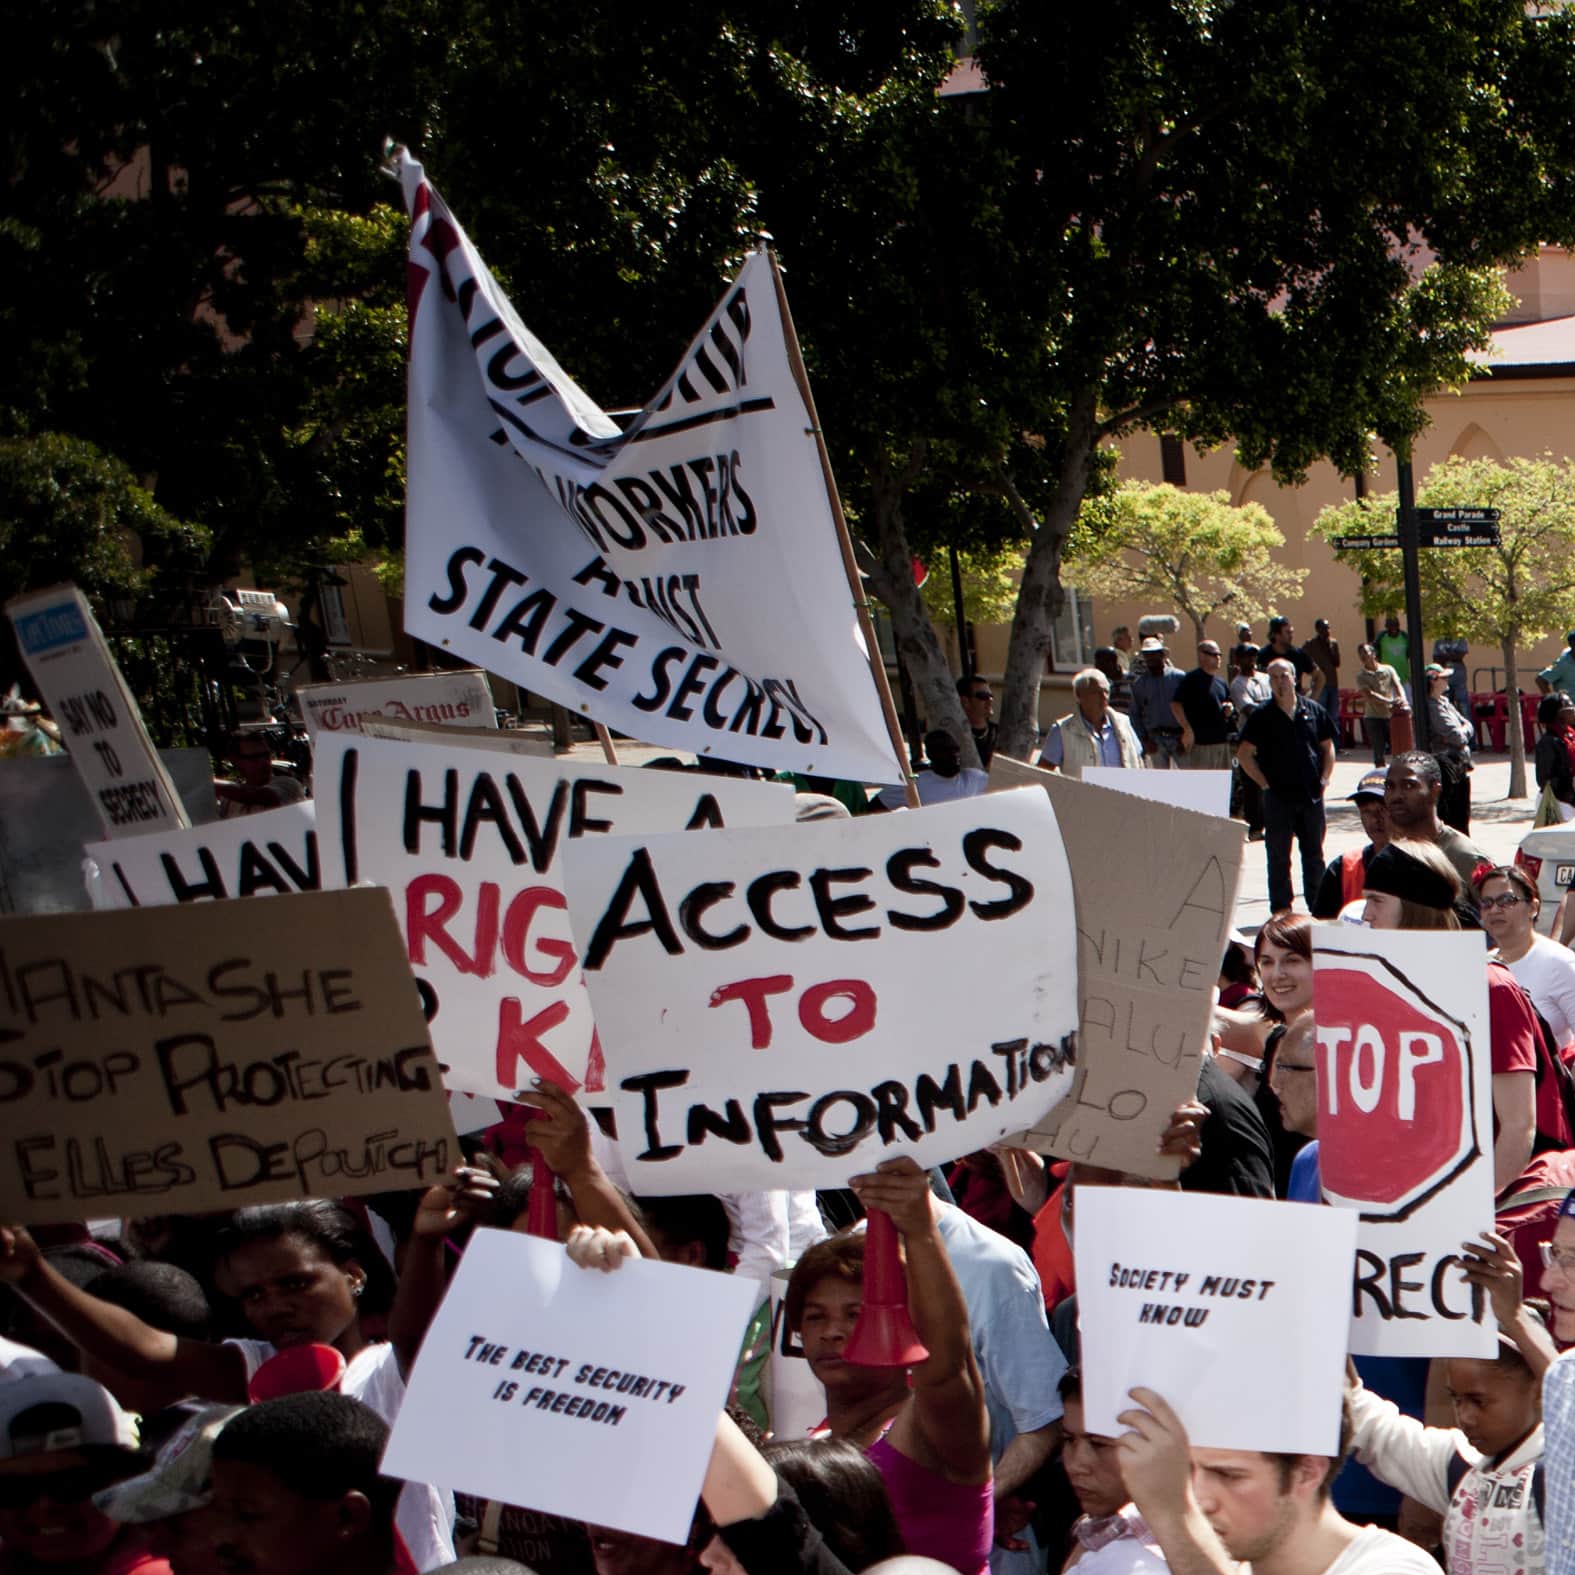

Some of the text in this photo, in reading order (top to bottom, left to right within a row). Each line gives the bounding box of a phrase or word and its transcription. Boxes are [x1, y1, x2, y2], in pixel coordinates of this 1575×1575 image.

[1433, 509, 1485, 520] Grand Parade
[1447, 523, 1470, 532] Castle
[1433, 536, 1491, 547] Railway Station
[428, 546, 639, 691] STATE
[59, 689, 118, 736] SAY NO
[385, 700, 471, 725] Argus
[93, 739, 123, 777] TO
[583, 827, 1035, 971] ACCESS
[708, 974, 877, 1050] TO
[153, 1032, 433, 1118] PROTECTING
[619, 1030, 1080, 1163] INFORMATION
[1199, 1274, 1278, 1302] MUST
[1137, 1303, 1211, 1329] KNOW
